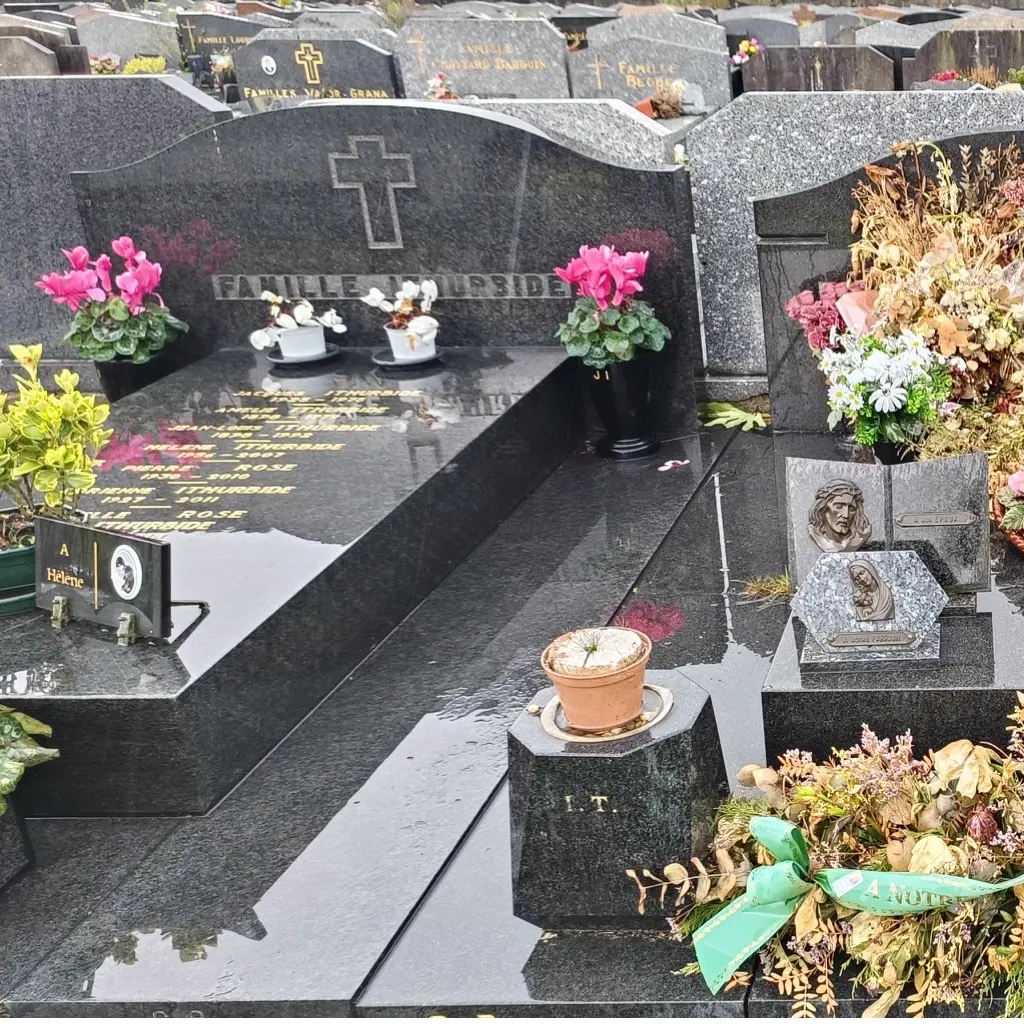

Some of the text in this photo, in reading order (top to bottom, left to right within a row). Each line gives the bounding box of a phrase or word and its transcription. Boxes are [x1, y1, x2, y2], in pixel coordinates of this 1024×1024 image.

[198, 36, 227, 44] FAMILLE
[618, 60, 676, 74] FAMILLE
[243, 87, 297, 98] FAMILLES
[350, 87, 389, 98] GRANA
[217, 275, 358, 298] FAMILLE
[233, 443, 346, 451] ITHURBIDE
[233, 464, 298, 472] ROSE
[174, 486, 296, 494] ITHURBIDE
[174, 496, 221, 504] 2011
[176, 510, 248, 519] ROSE
[60, 543, 69, 557] A
[46, 568, 84, 588] Hélène
[864, 879, 880, 900] A
